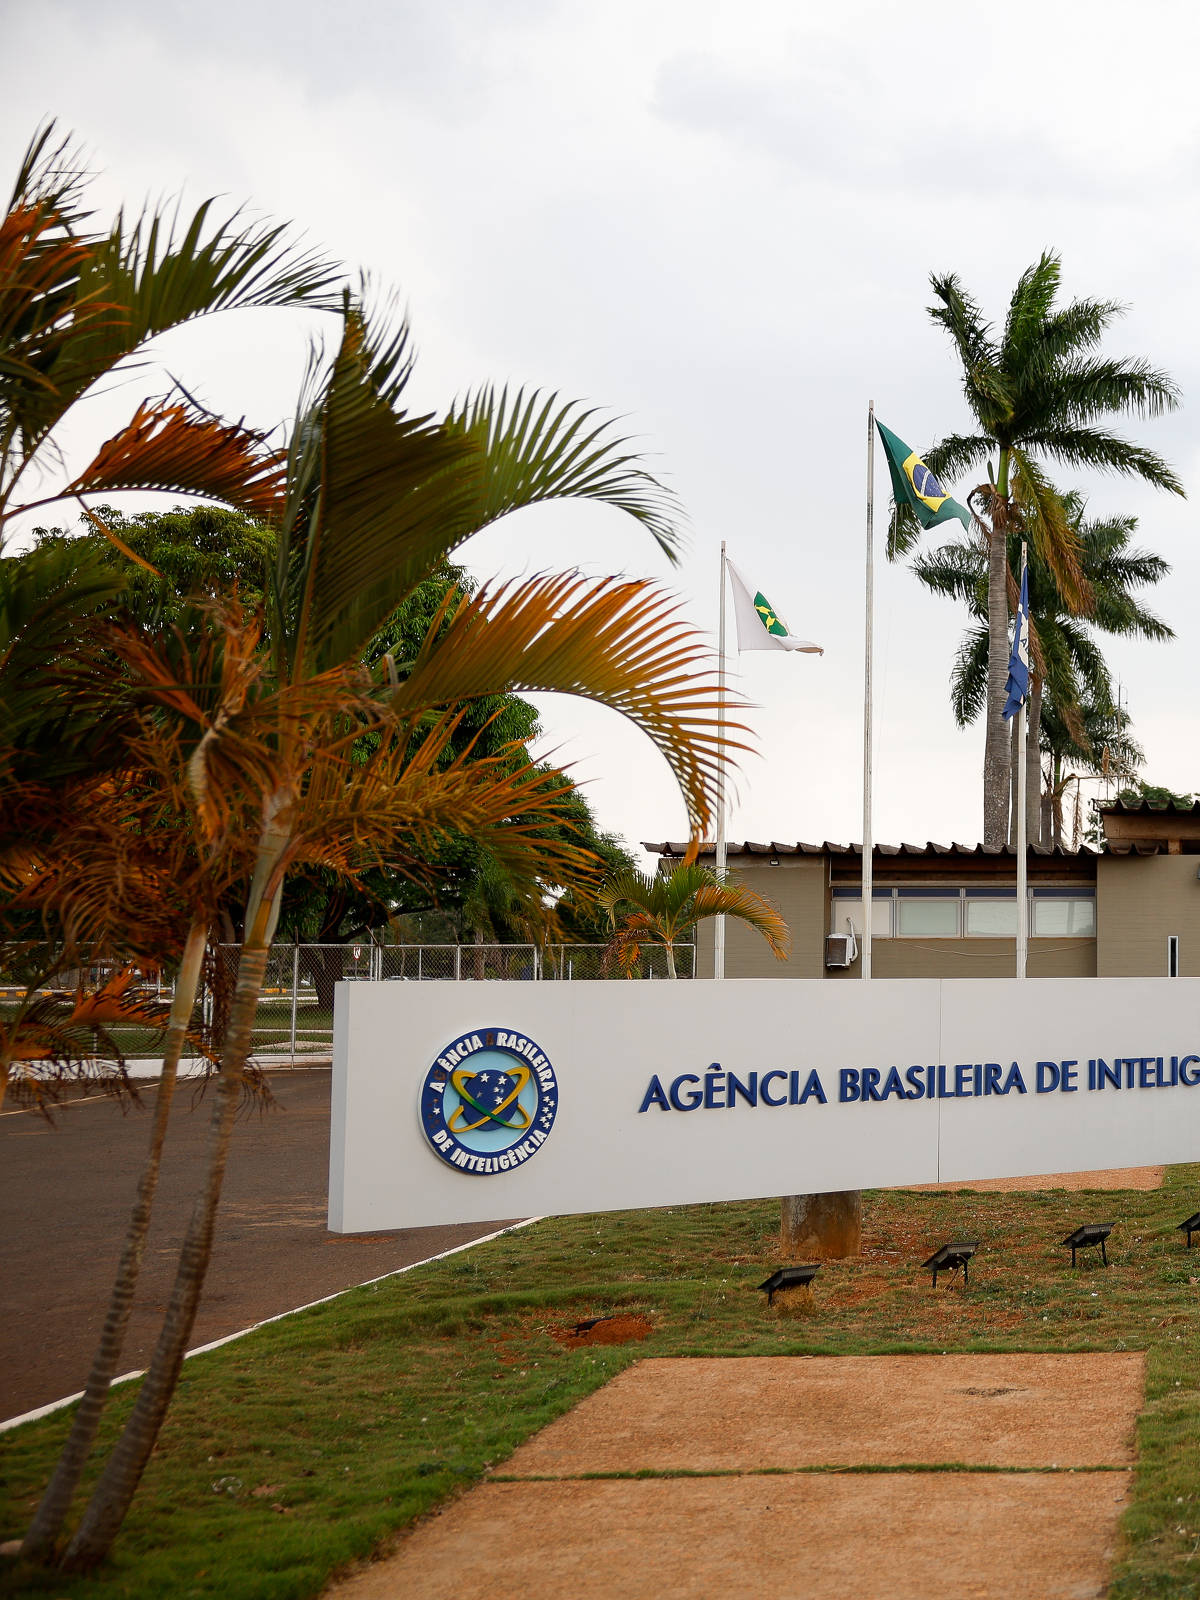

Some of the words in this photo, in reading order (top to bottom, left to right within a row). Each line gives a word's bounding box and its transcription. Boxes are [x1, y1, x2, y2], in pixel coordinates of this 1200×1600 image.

[638, 1062, 828, 1114] AGÊNCIA
[838, 1061, 1027, 1103] BRASILEIRA
[1035, 1060, 1078, 1094] DE
[432, 1129, 454, 1153] DE
[449, 1129, 547, 1173] INTELIGÊNCIA
